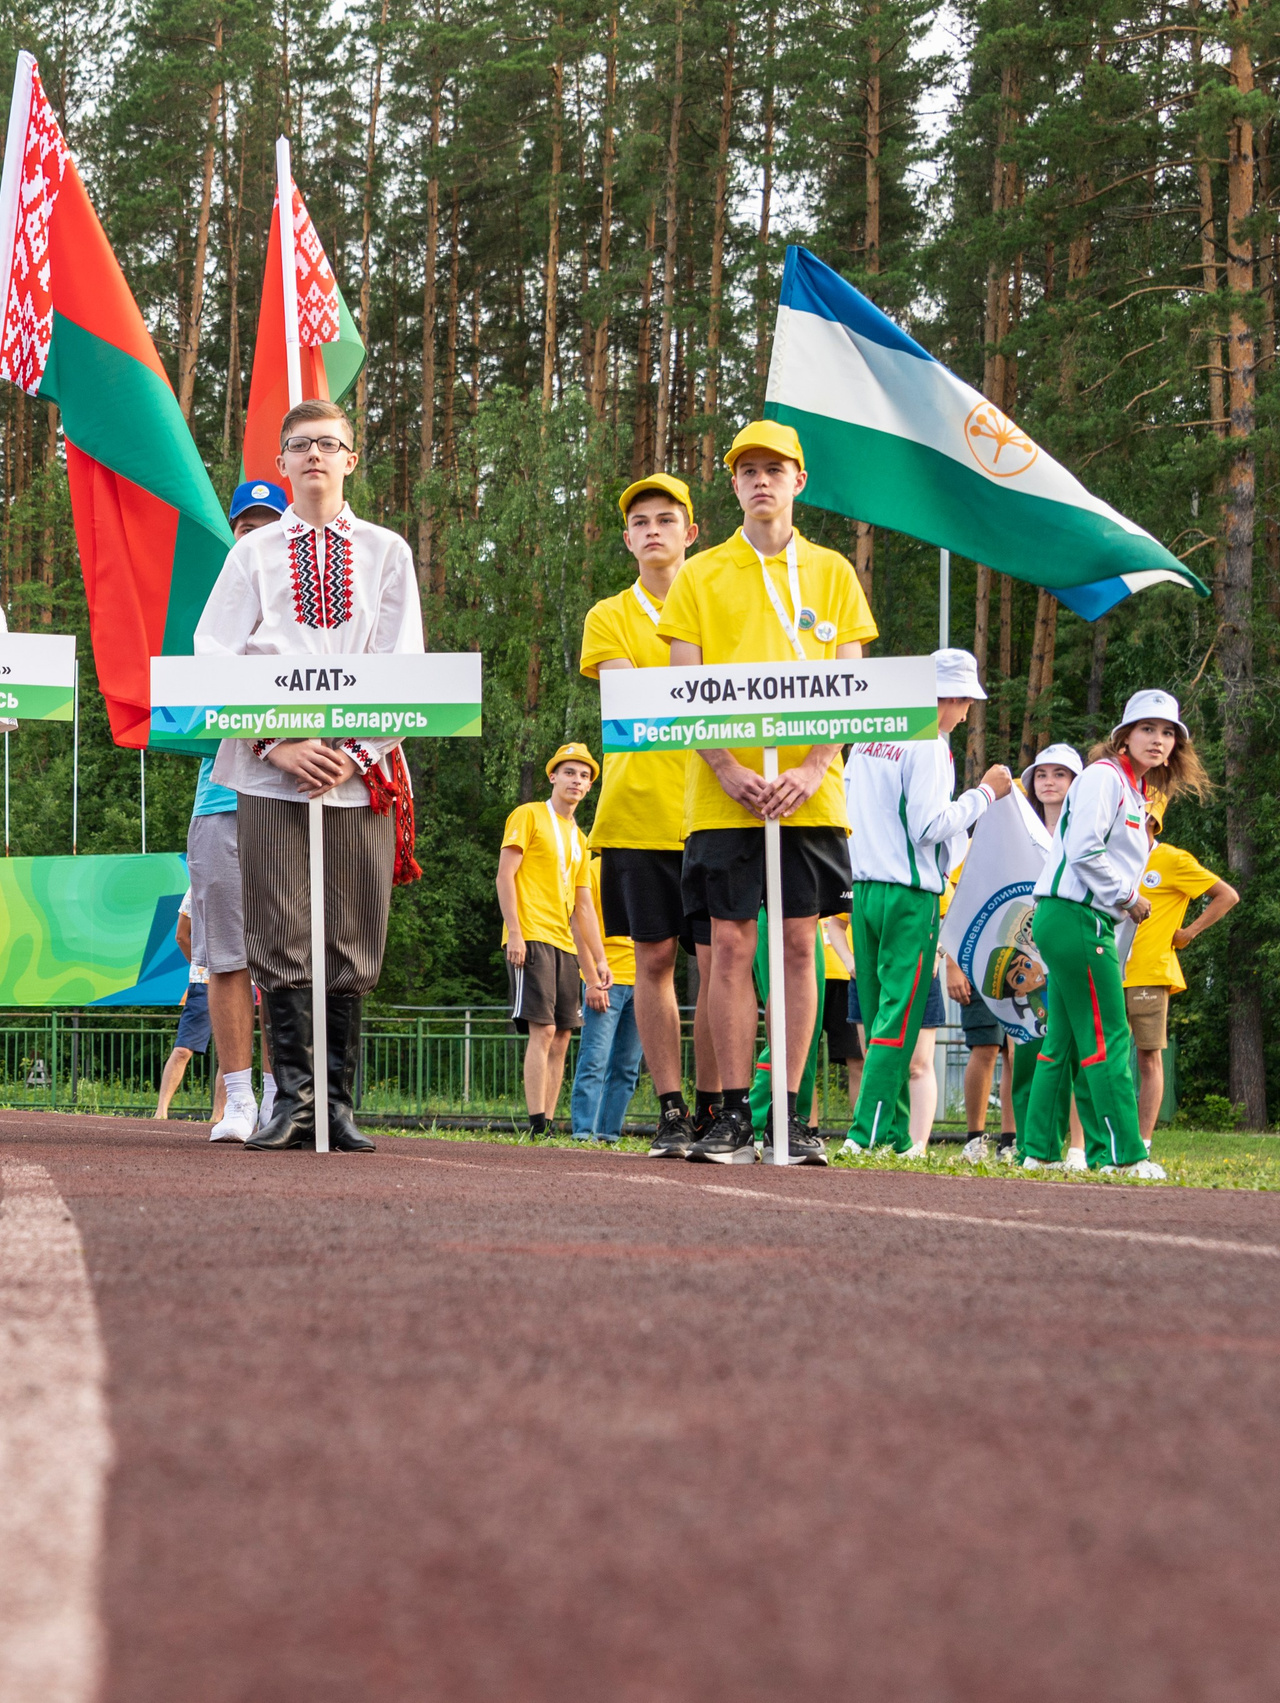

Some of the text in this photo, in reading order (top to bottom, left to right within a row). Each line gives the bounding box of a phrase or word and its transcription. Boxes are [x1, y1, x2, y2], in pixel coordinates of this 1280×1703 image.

[274, 668, 357, 691] «АГАТ»
[670, 674, 868, 704] «УФА-КОНТАКТ»
[205, 708, 428, 733] Республика Беларусь
[633, 716, 908, 745] Республика Башкортостан
[987, 884, 1035, 910] олимпи
